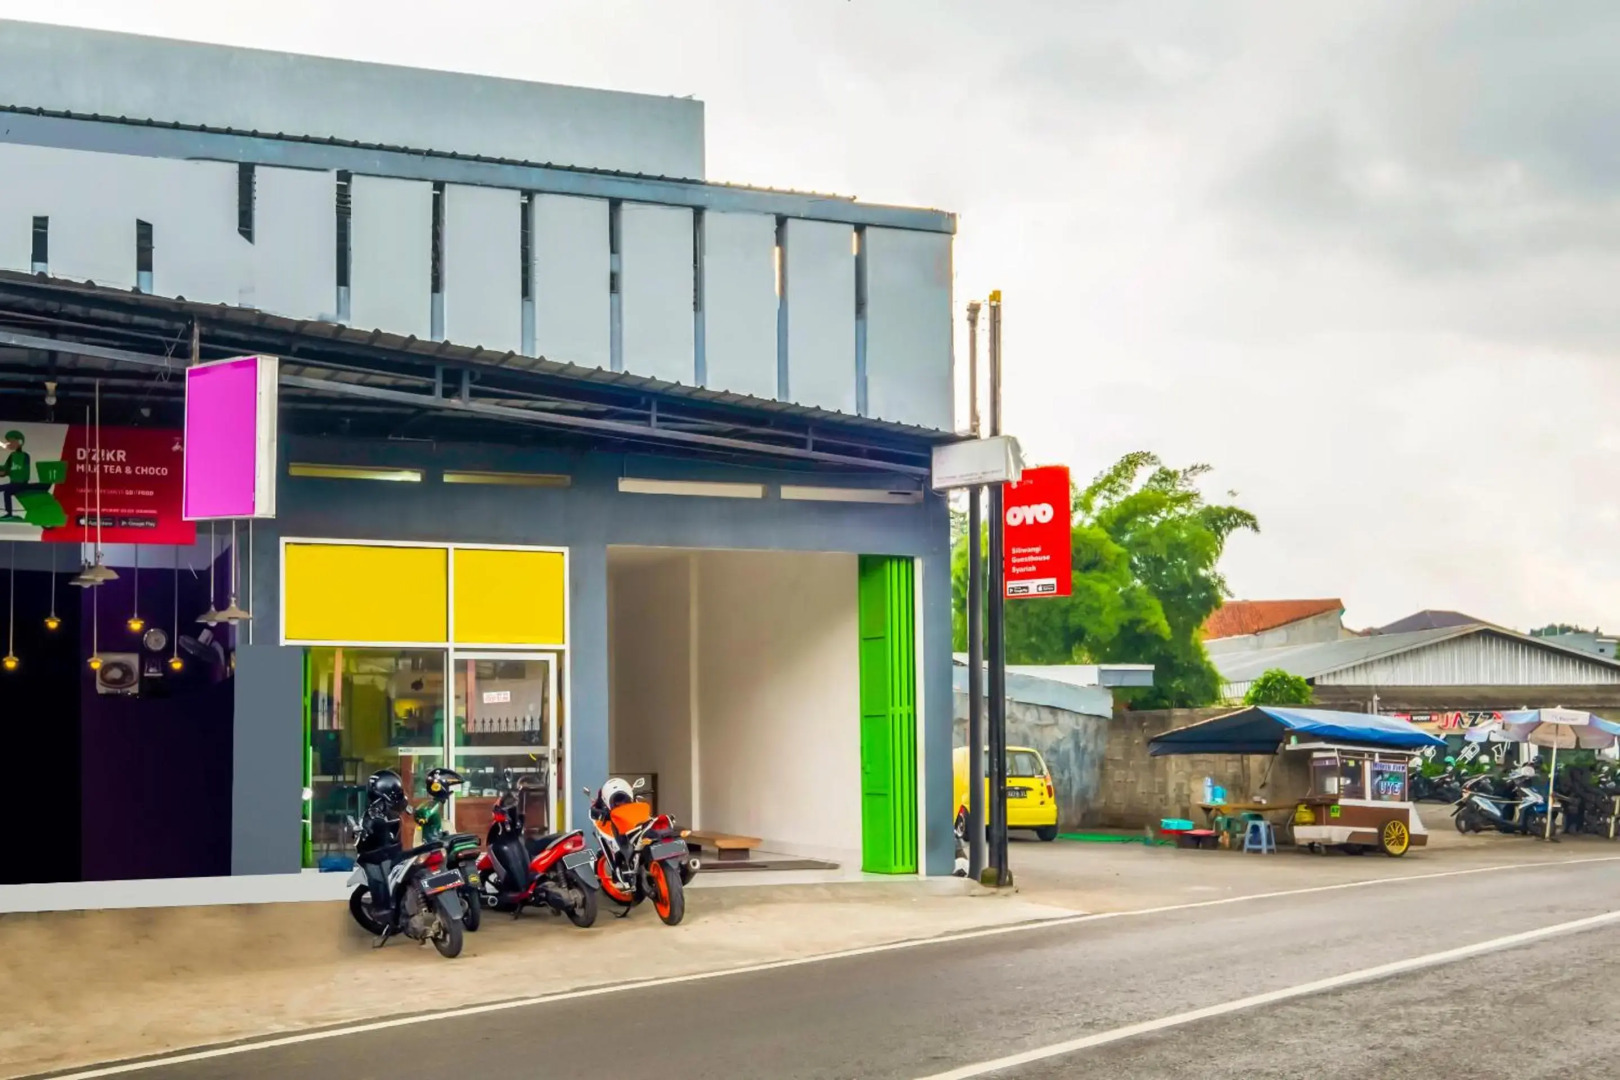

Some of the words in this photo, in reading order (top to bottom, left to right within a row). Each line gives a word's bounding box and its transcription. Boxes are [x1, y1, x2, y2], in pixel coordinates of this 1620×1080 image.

[76, 463, 100, 473] MLK
[103, 464, 122, 474] TEA
[124, 466, 132, 475] &
[135, 466, 168, 476] CHOCO
[1006, 503, 1054, 526] OYO
[1011, 545, 1042, 554] Siliwangi
[1011, 555, 1051, 563] Guesthouse
[1011, 565, 1037, 574] Syariah
